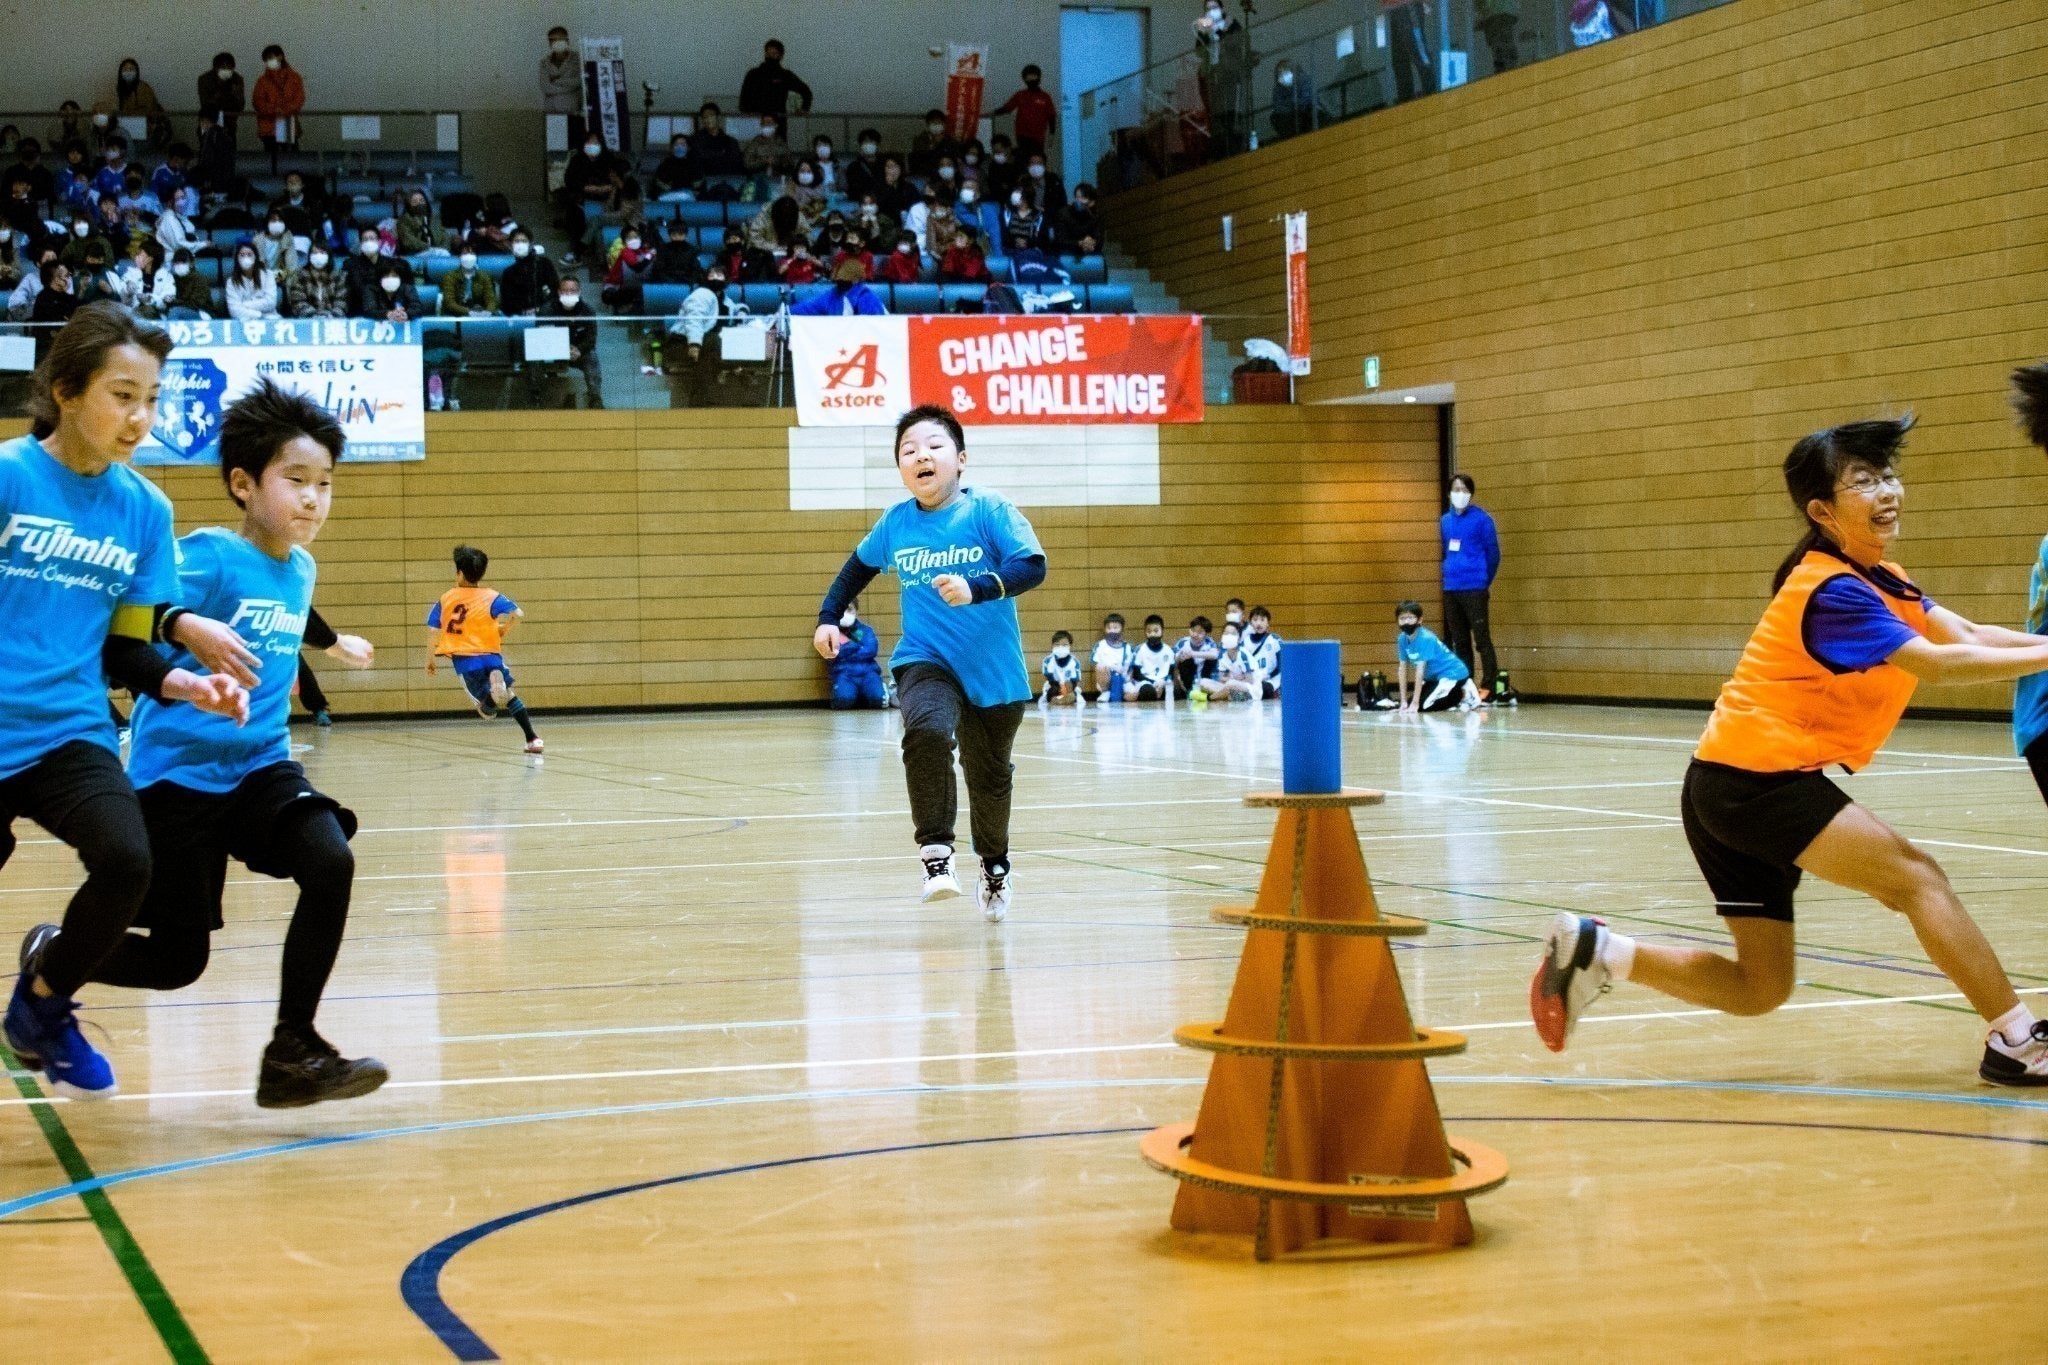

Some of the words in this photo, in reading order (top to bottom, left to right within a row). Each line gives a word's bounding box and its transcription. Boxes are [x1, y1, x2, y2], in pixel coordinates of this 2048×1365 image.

[255, 358, 376, 374] 仲間を信じて
[938, 324, 1088, 377] CHANGE
[820, 392, 886, 409] astore
[951, 385, 977, 413] &
[987, 374, 1168, 415] CHALLENGE
[893, 544, 984, 576] Fujimino
[446, 603, 469, 635] 2
